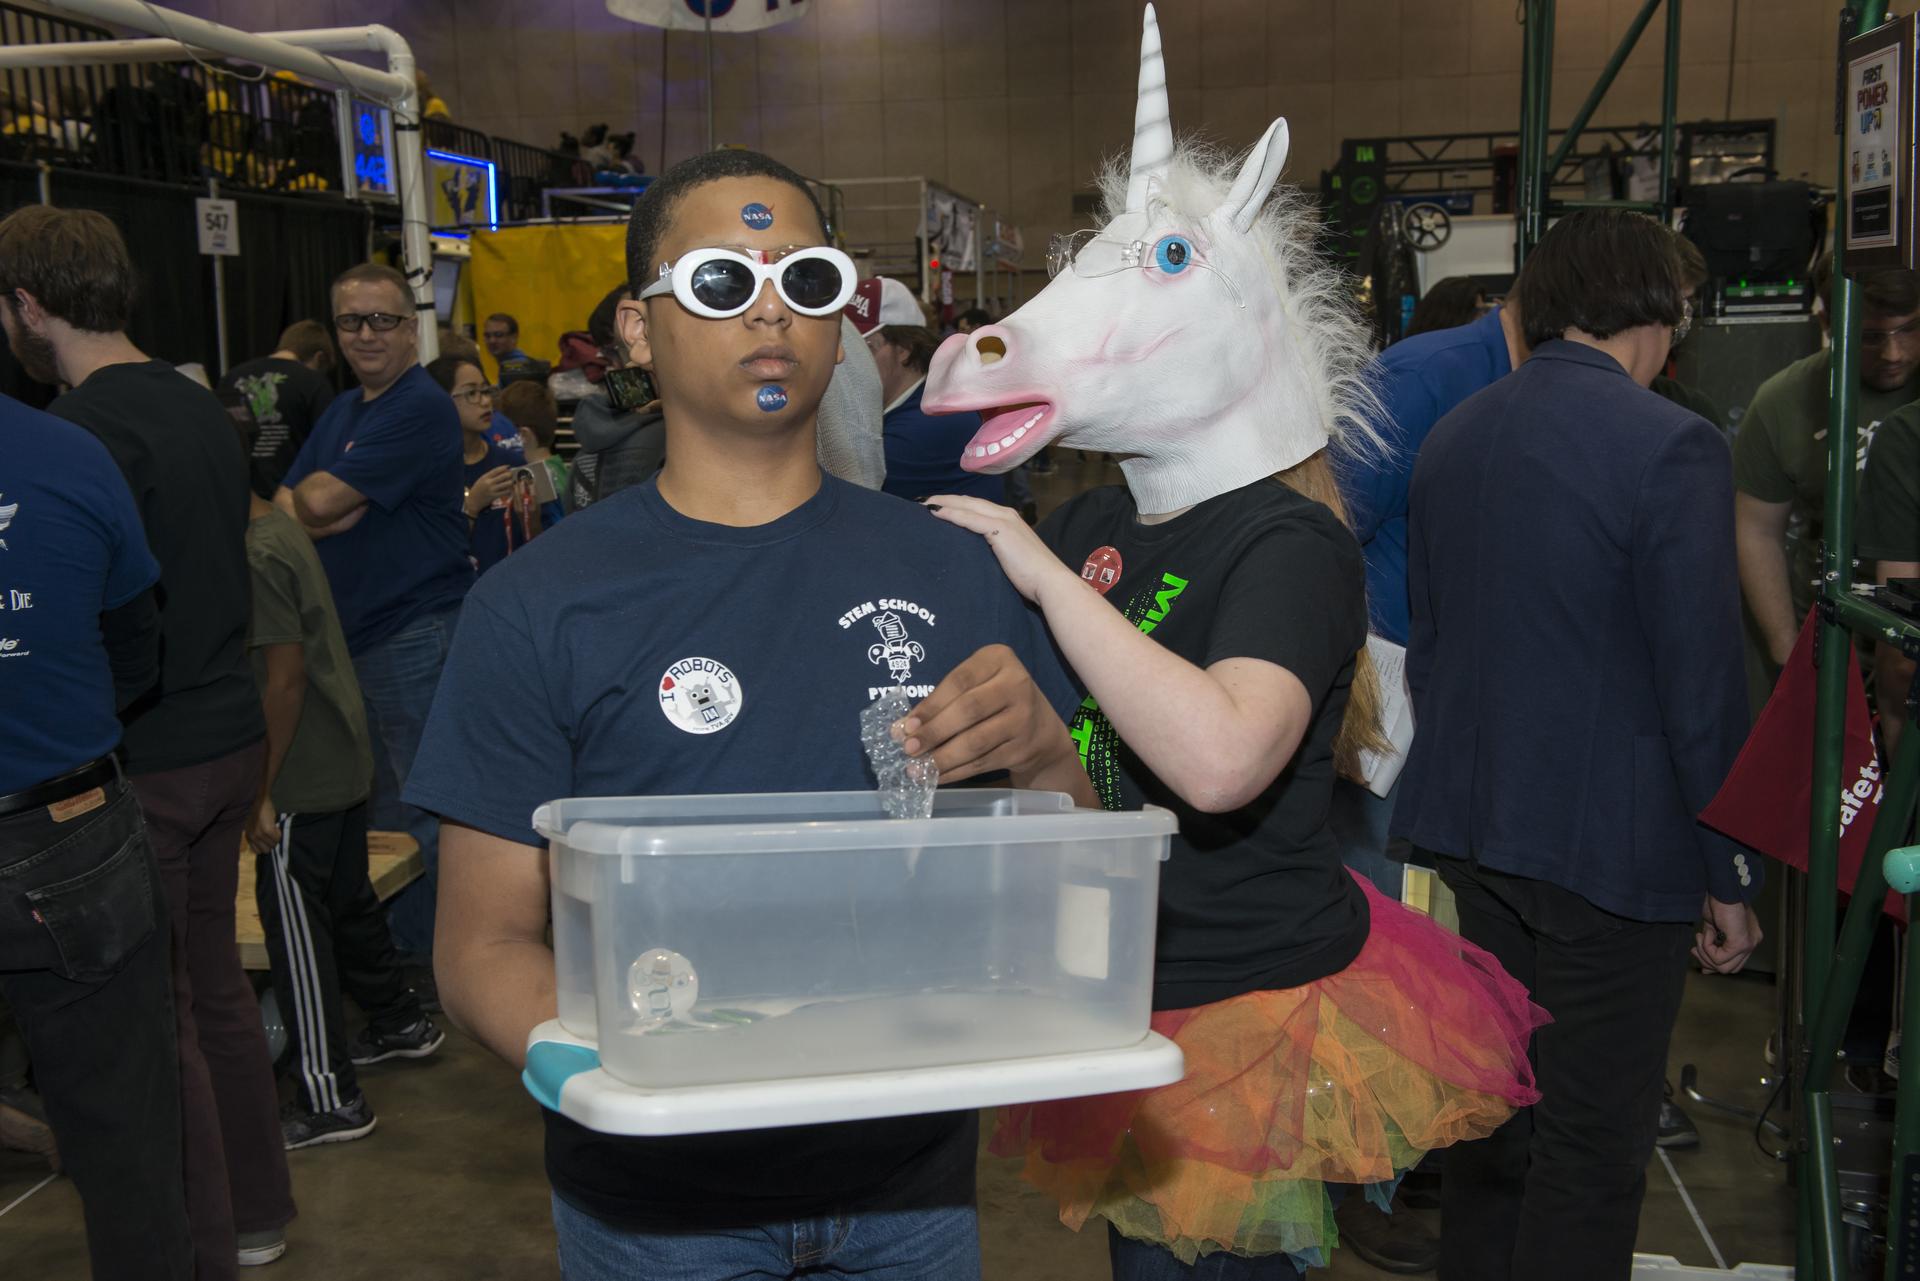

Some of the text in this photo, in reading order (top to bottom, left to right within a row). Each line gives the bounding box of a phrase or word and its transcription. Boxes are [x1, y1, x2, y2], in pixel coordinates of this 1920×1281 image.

[1857, 81, 1888, 113] POWER
[205, 212, 229, 231] 547
[743, 211, 772, 221] NASA
[759, 391, 787, 403] NASA
[838, 599, 936, 629] STEM SCHOOL
[891, 660, 908, 669] 4924
[661, 658, 734, 702] I ROBOTS
